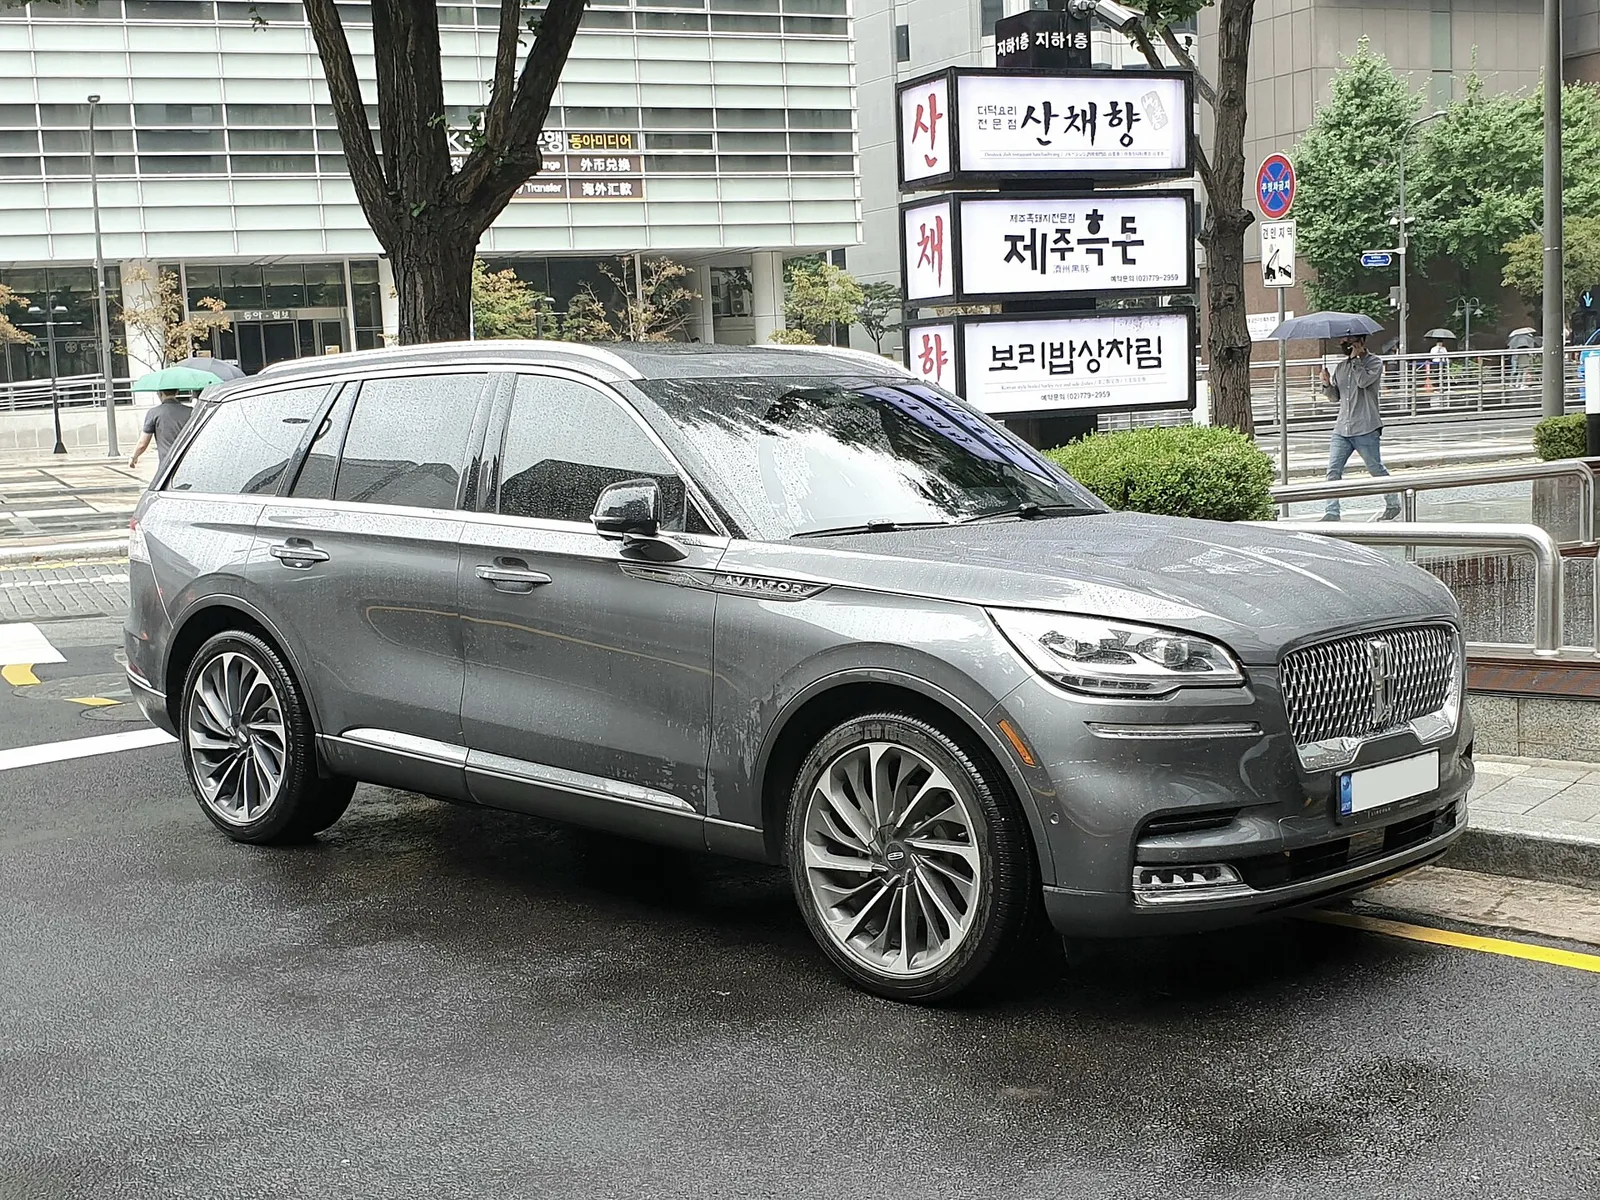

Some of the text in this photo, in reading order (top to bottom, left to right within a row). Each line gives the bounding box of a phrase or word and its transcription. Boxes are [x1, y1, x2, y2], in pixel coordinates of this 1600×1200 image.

[997, 32, 1030, 56] 지하1층
[1035, 31, 1089, 49] 지하1층
[977, 105, 1017, 116] 더덕요리
[912, 93, 944, 168] 산
[977, 119, 1017, 130] 전문점
[1020, 101, 1142, 147] 산채향
[568, 133, 632, 150] 동아미디어
[580, 157, 631, 172] 外币兑换
[525, 183, 562, 193] Transfer
[582, 182, 633, 196] 海外汇款
[1261, 180, 1291, 193] 주정차금지
[1009, 213, 1076, 224] 제주흑돼지전문점
[1262, 226, 1293, 240] 견인지역
[916, 215, 944, 288] 채
[1136, 273, 1179, 282] (02)779-2959
[988, 335, 1162, 376] 보리밥상차림
[1067, 390, 1111, 401] (02)779-2959
[725, 575, 804, 594] AVIATOR
